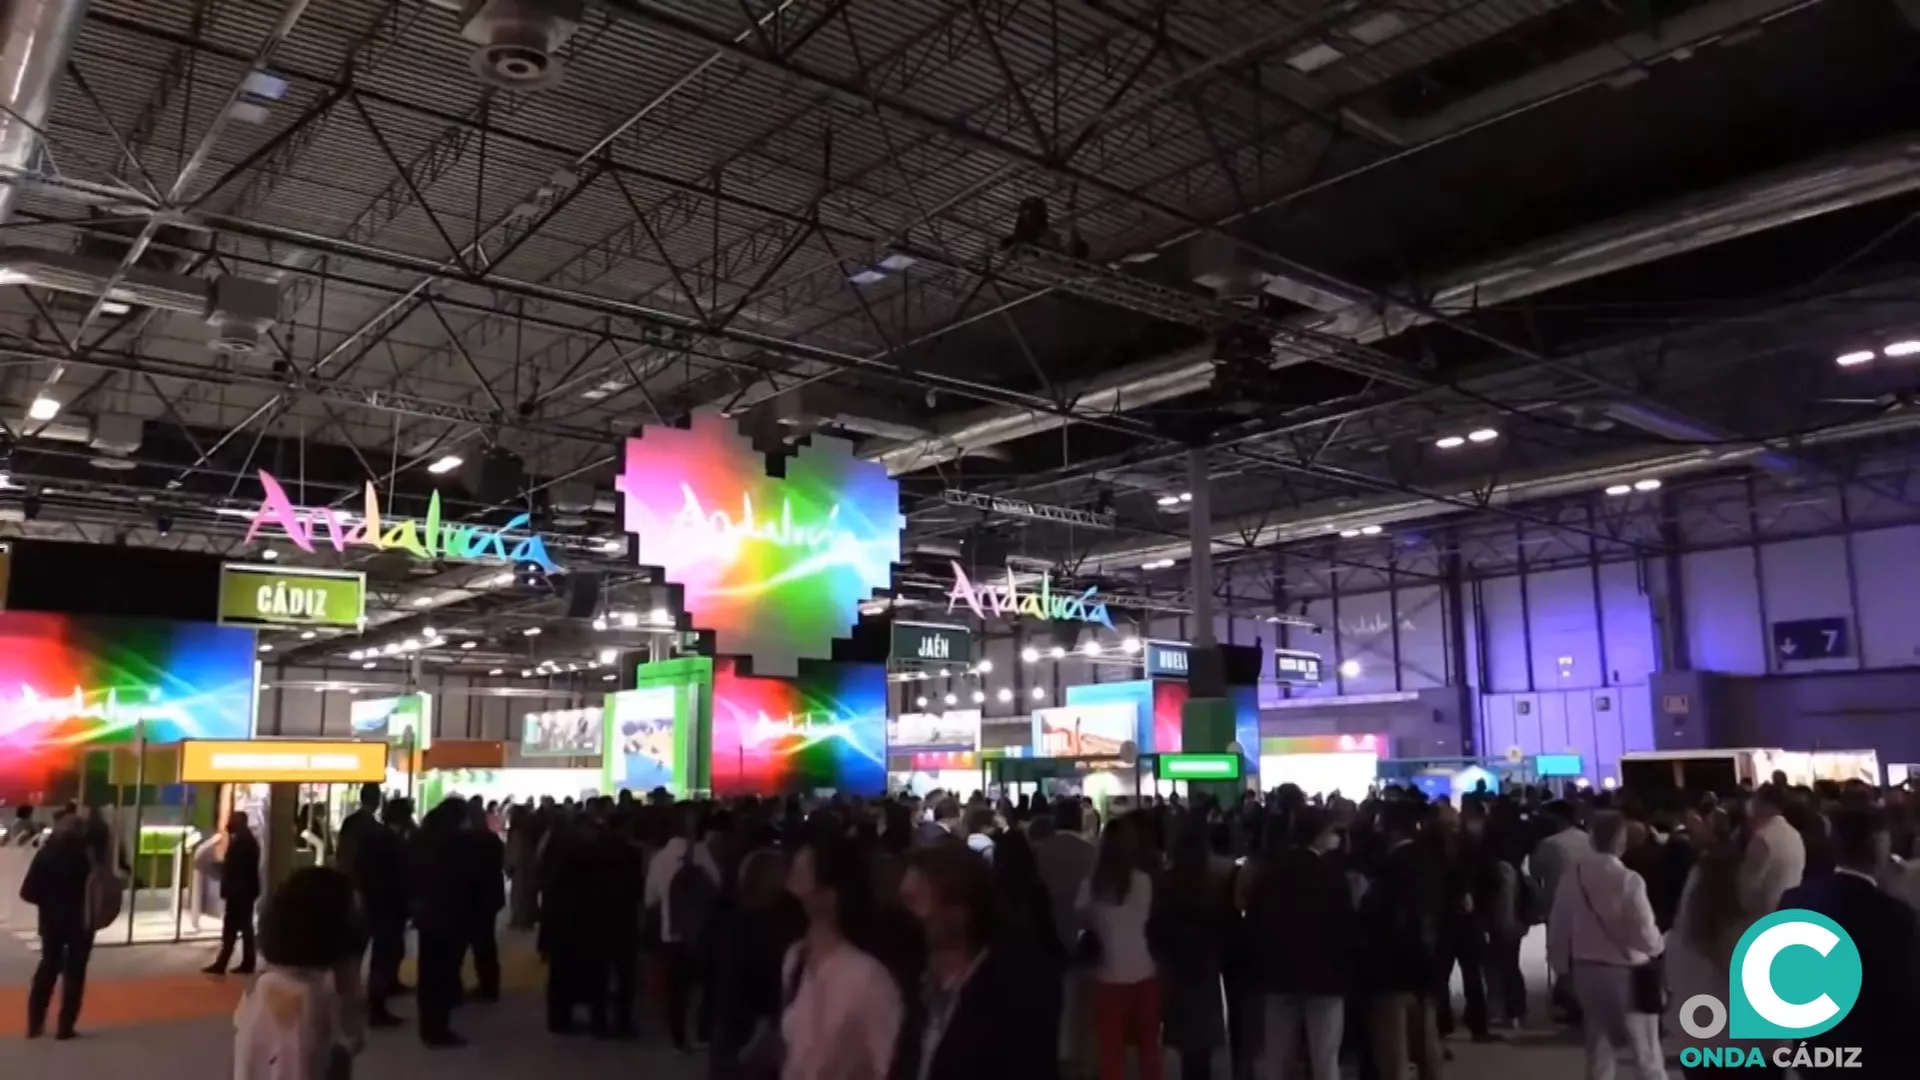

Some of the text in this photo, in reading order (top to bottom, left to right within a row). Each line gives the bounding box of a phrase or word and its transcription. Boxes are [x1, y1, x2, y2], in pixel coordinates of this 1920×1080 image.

[244, 467, 566, 574] Andalucía
[256, 580, 328, 617] CÁDIZ
[945, 560, 1118, 632] Andalucía
[918, 633, 949, 658] JAÉN
[1820, 629, 1838, 653] 7
